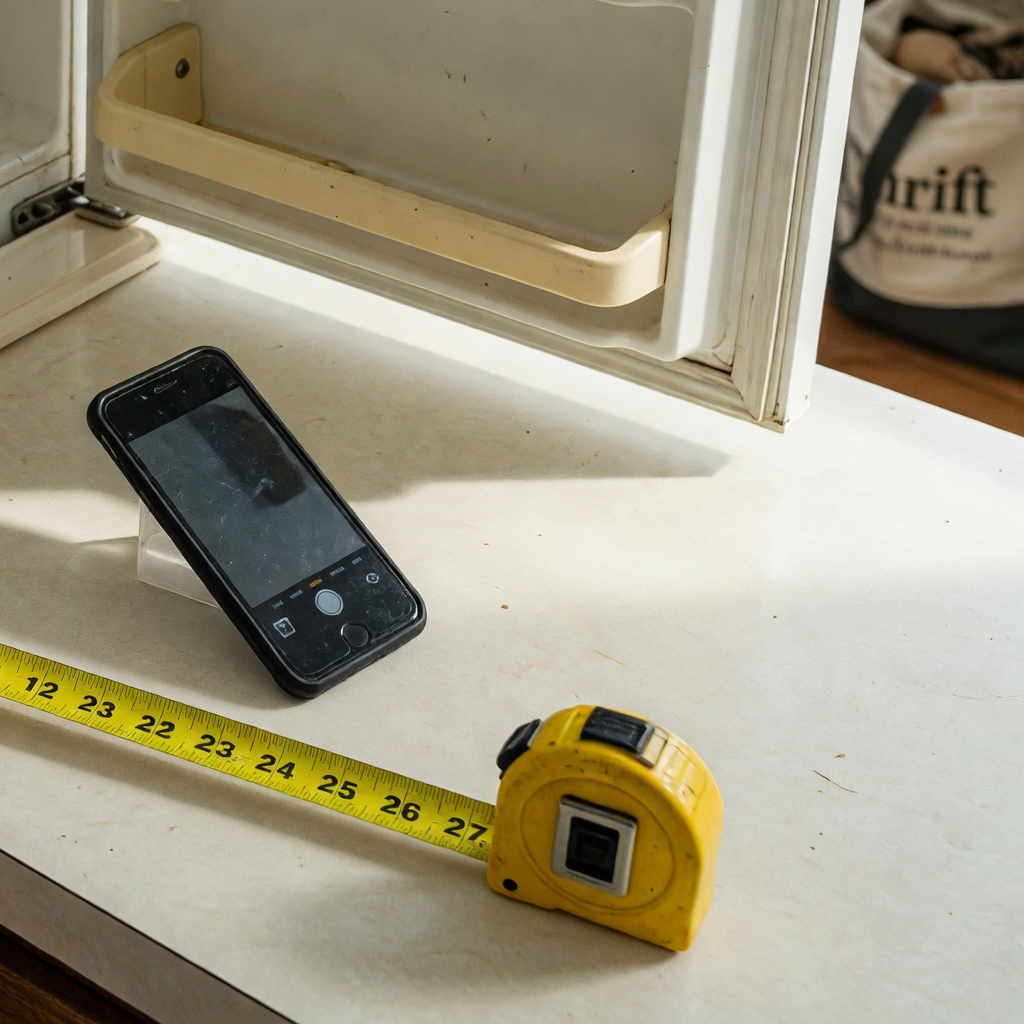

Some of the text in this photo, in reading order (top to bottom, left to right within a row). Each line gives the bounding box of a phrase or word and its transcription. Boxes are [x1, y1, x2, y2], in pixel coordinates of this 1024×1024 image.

[25, 676, 59, 700] 12
[77, 695, 116, 719] 23
[134, 714, 176, 739] 22
[194, 733, 236, 758] 23
[254, 754, 296, 780] 24
[317, 774, 358, 800] 25
[379, 794, 421, 822] 26
[443, 817, 488, 842] 27
